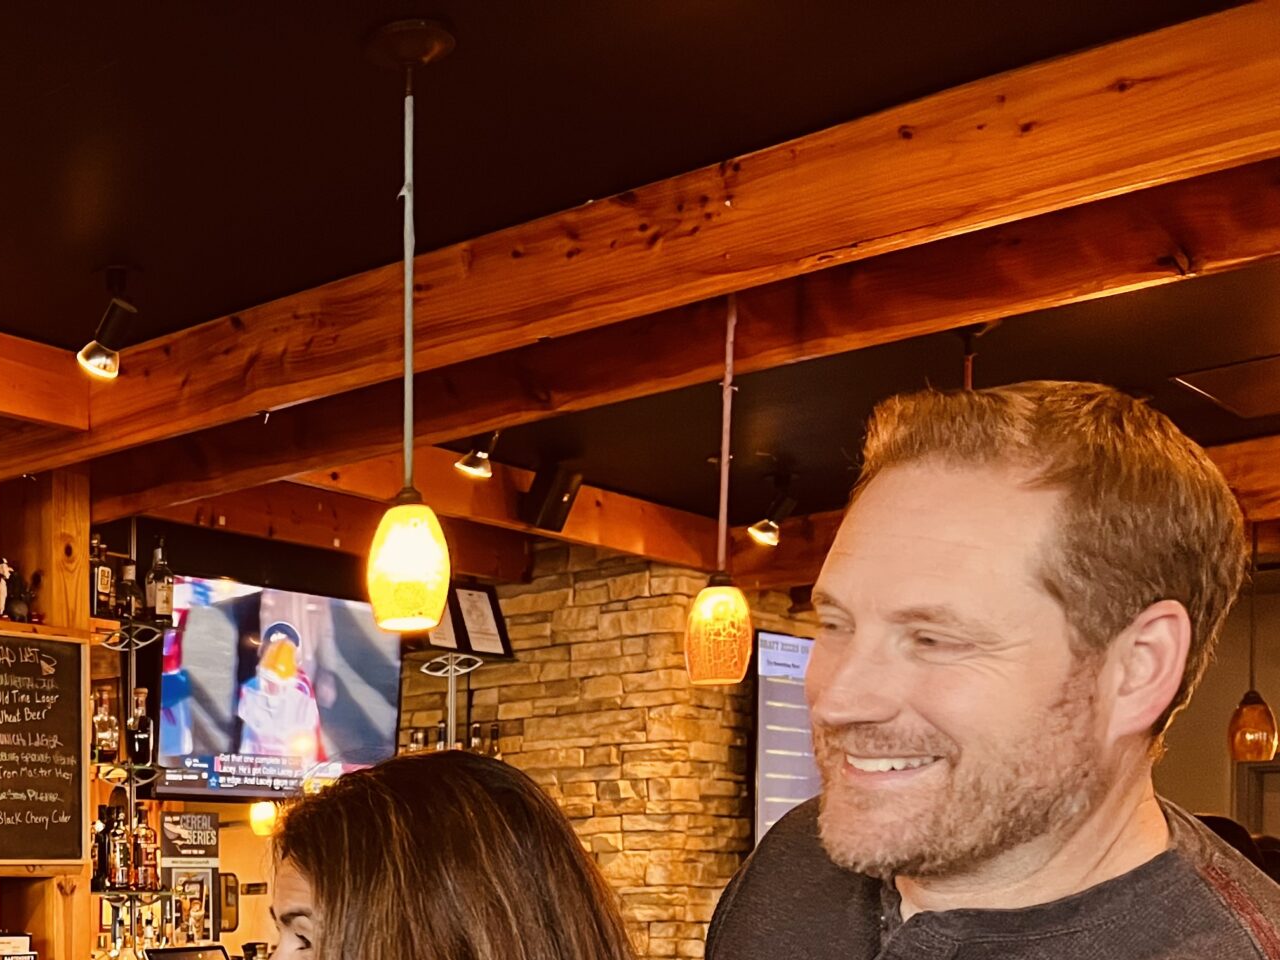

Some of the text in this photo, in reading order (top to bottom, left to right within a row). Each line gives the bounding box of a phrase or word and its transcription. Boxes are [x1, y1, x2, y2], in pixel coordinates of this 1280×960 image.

[24, 707, 48, 721] Beer
[20, 766, 52, 778] Master
[25, 810, 50, 835] Cherry
[51, 809, 71, 823] Cider
[180, 815, 211, 830] CEREAL
[187, 830, 217, 846] SERIES
